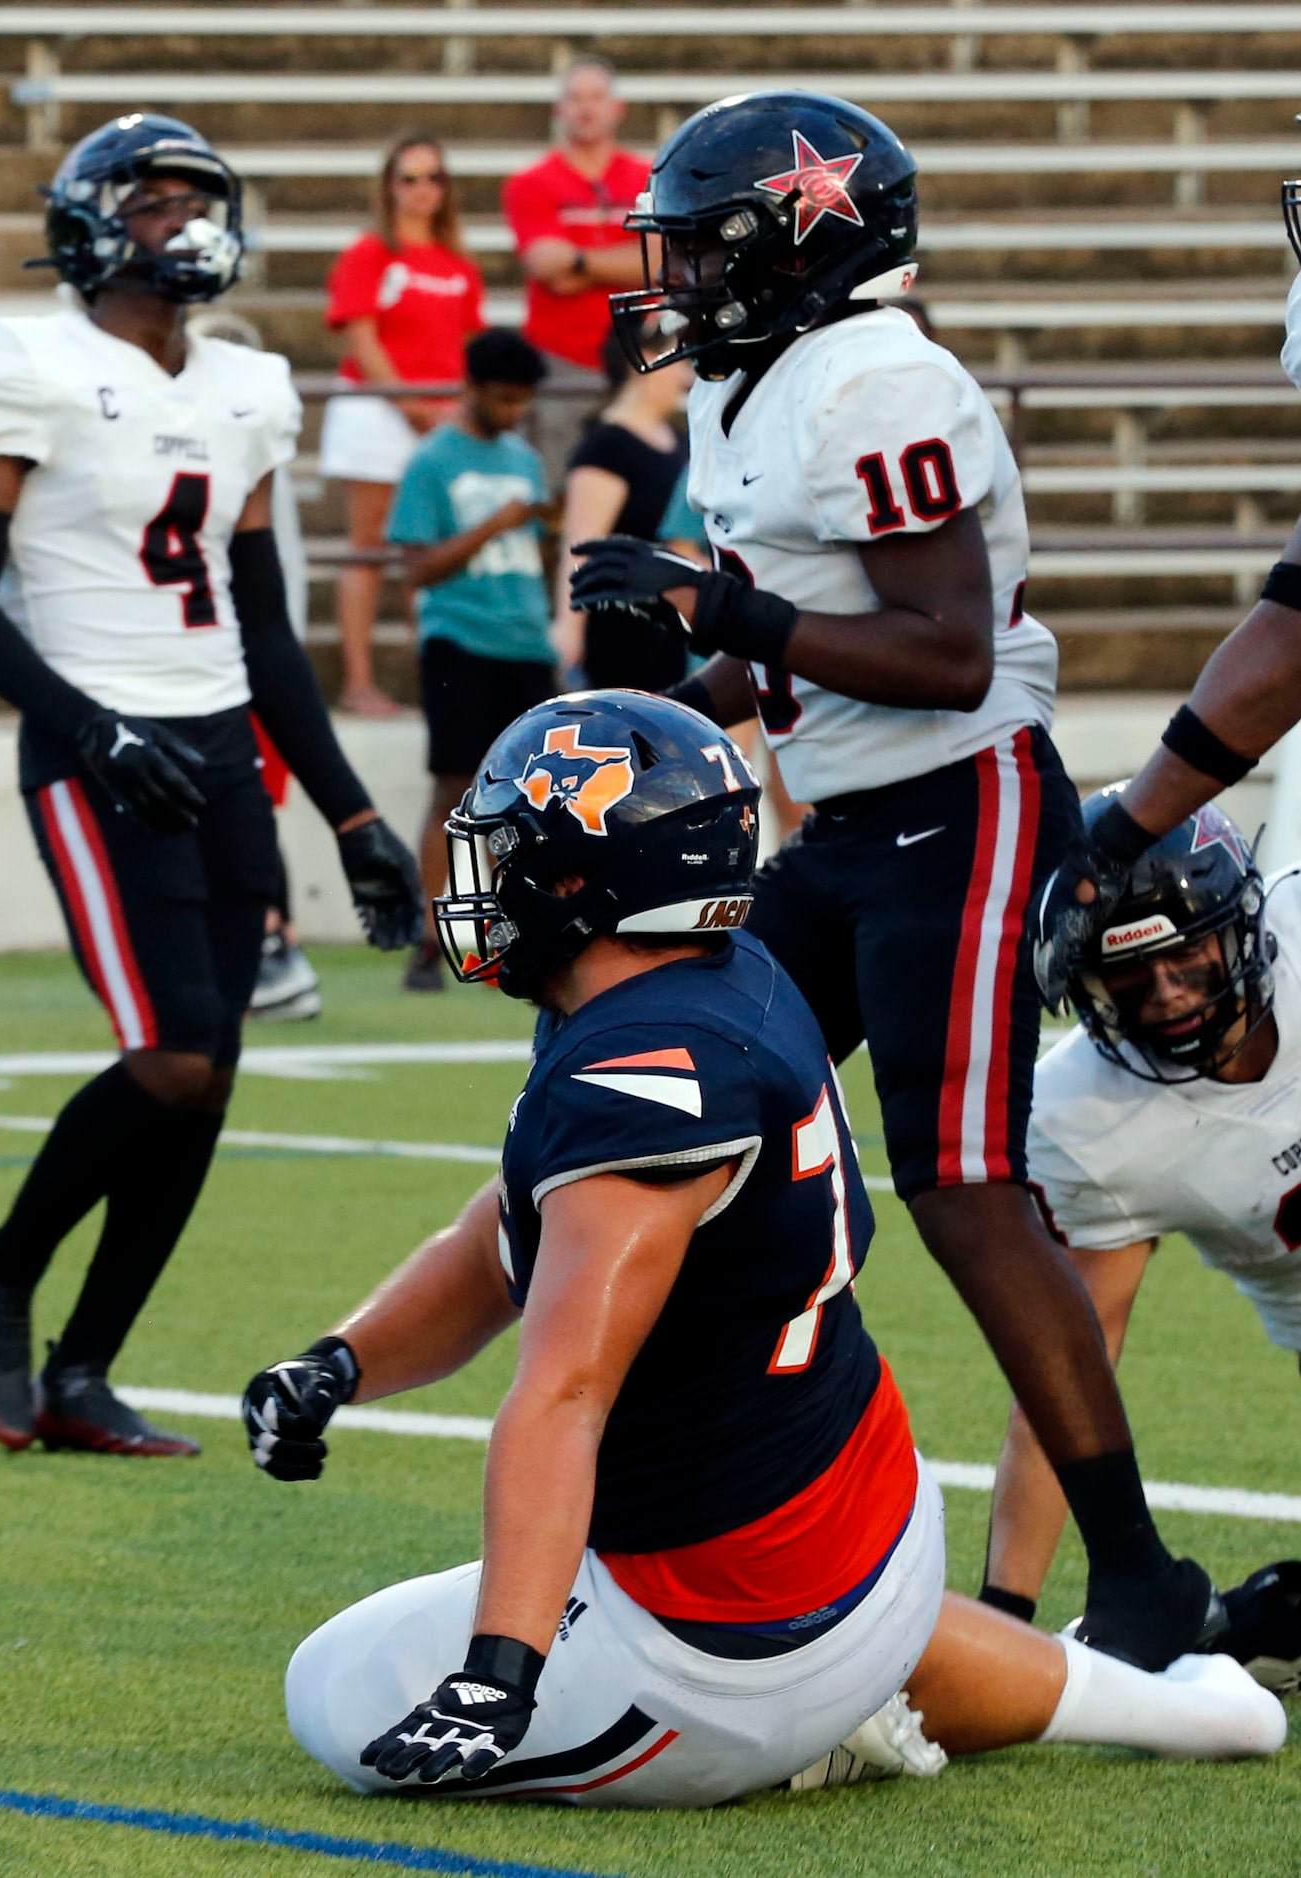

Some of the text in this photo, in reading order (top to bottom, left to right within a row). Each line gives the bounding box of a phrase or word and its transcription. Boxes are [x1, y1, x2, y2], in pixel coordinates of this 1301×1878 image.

[98, 387, 120, 421] C
[855, 437, 962, 535] 10
[138, 472, 220, 629] 4
[1107, 922, 1164, 947] Riddell
